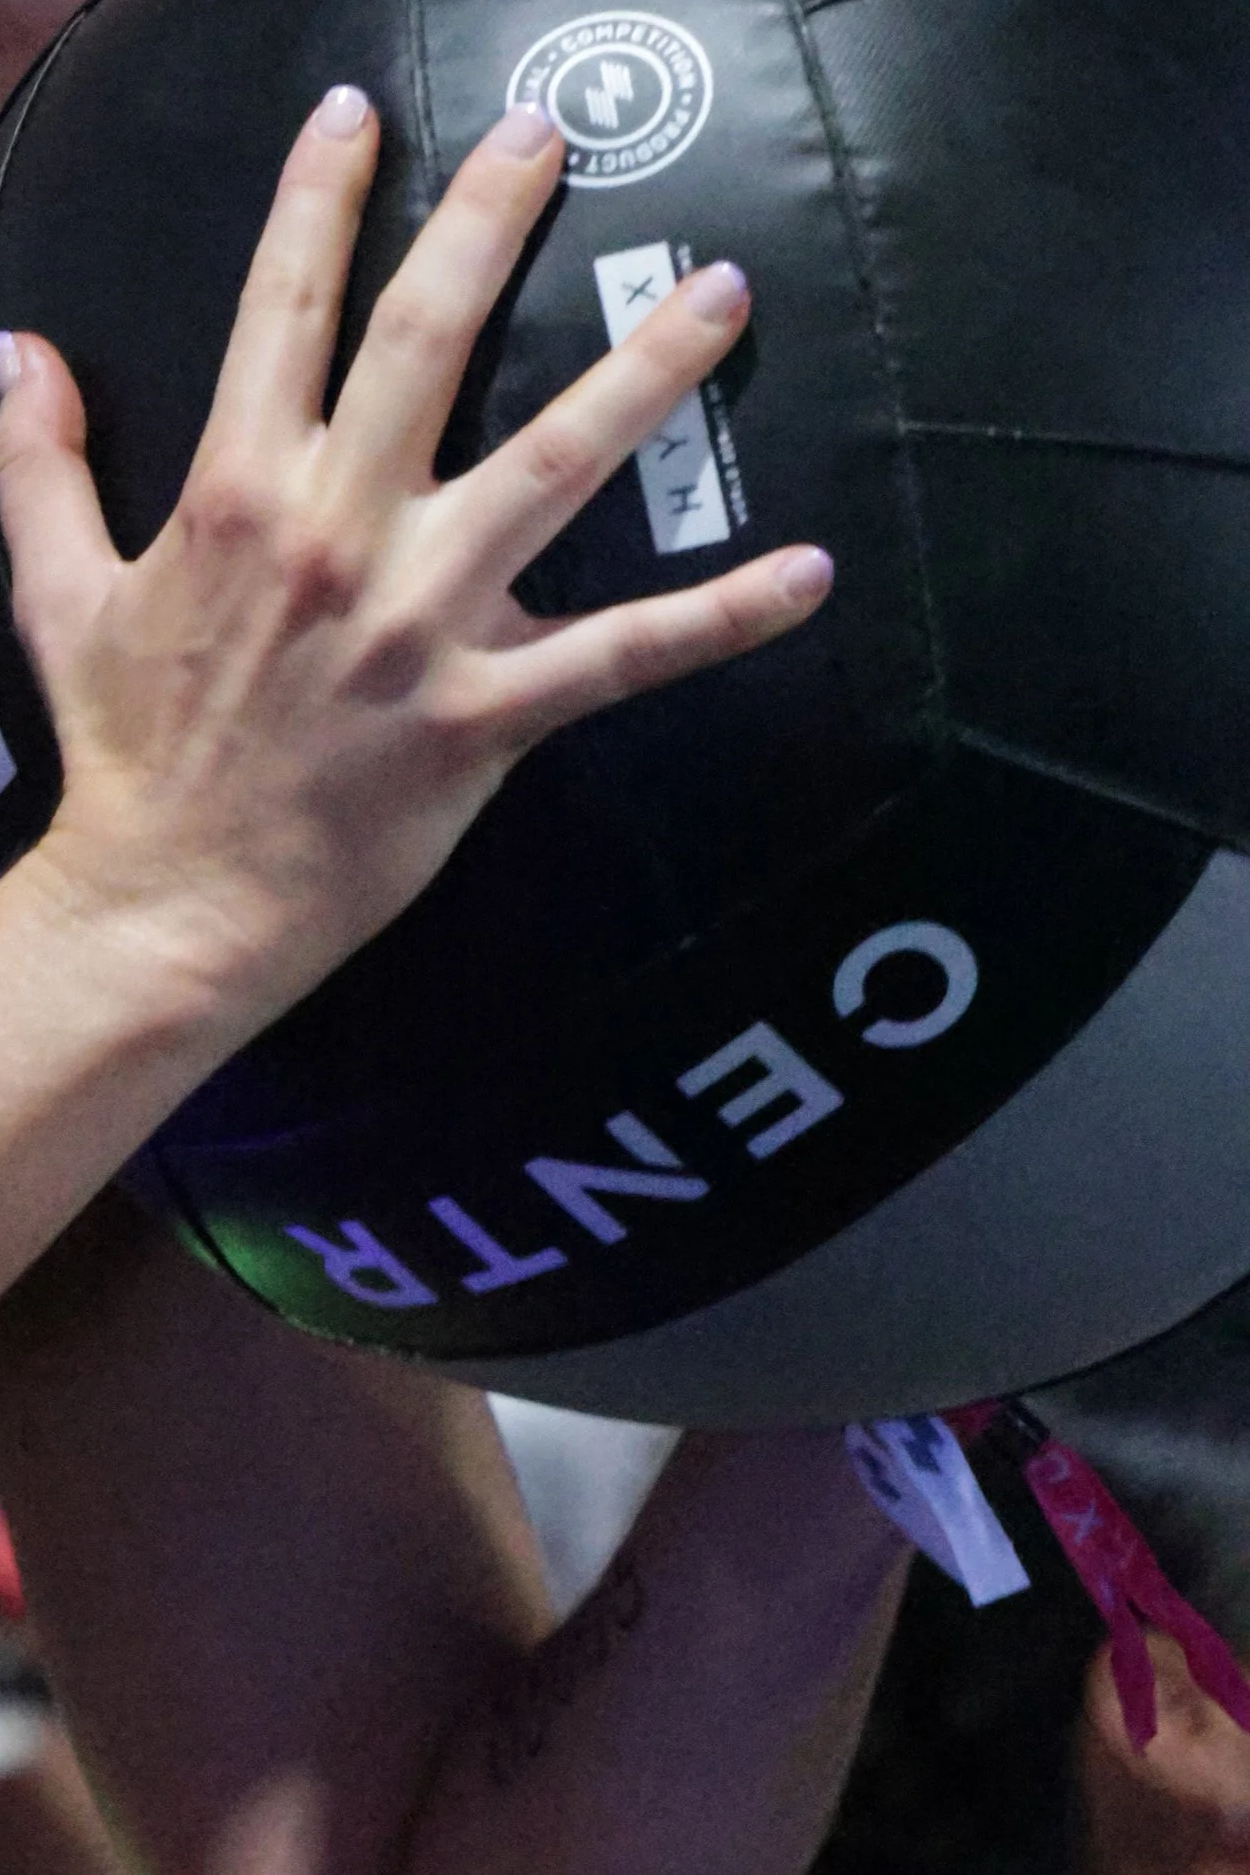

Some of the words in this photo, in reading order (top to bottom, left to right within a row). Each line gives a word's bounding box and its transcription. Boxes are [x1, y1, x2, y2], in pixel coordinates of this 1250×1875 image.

[561, 23, 696, 90] COMPETITION
[584, 108, 692, 174] PRODUCT
[621, 275, 702, 514] HYX
[284, 921, 979, 1309] CENTR
